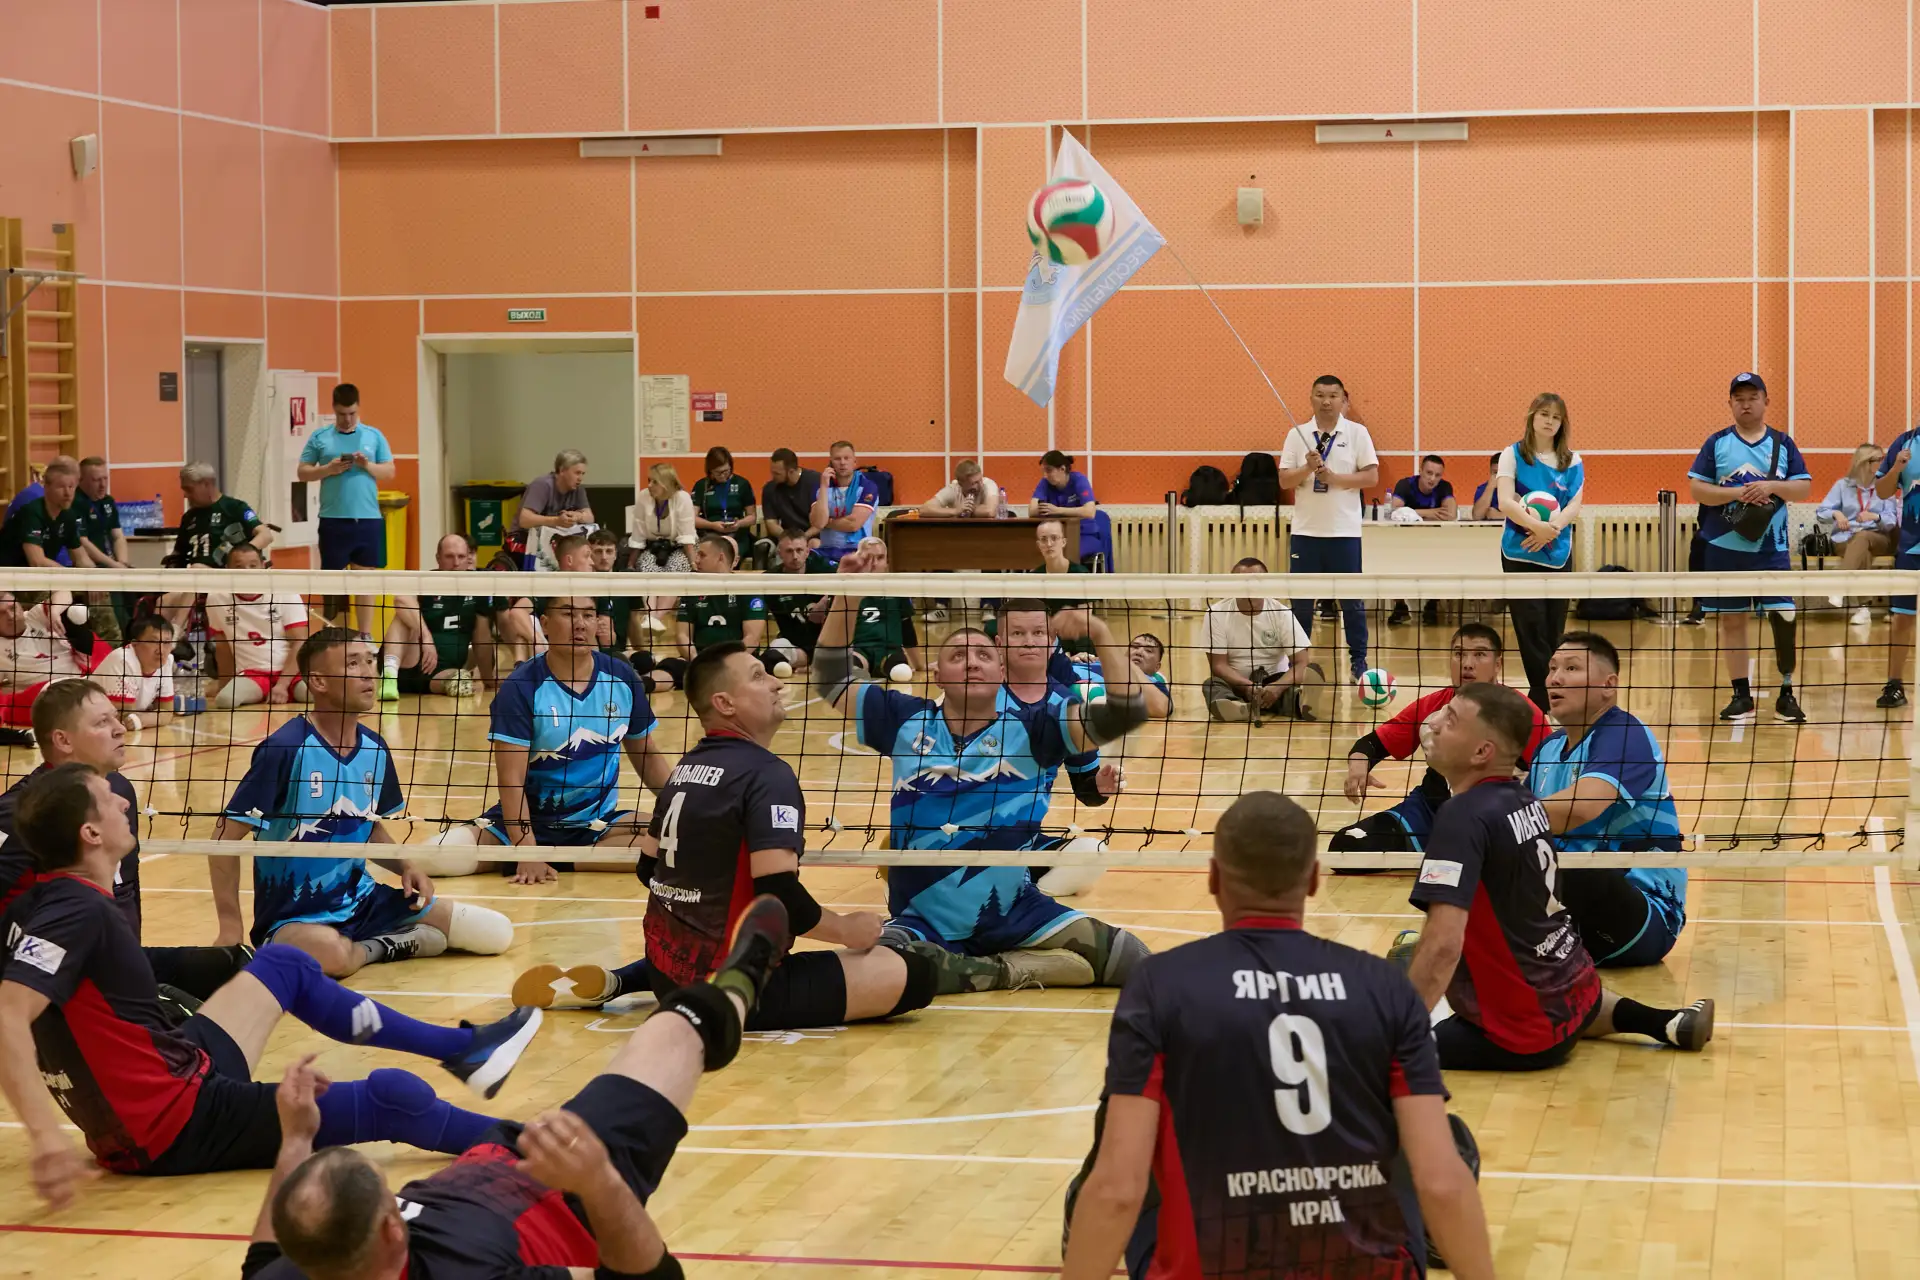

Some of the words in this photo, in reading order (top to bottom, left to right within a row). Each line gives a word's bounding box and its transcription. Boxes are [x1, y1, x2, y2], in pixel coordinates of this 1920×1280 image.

[510, 310, 542, 320] ВЫХОД
[862, 606, 881, 623] 2
[551, 705, 560, 727] 1
[310, 771, 324, 798] 9
[659, 791, 687, 868] 4
[1536, 838, 1565, 918] 2
[1232, 969, 1347, 1003] ЯРГИН
[1268, 1013, 1332, 1135] 9
[1226, 1160, 1387, 1197] КРАСНОЯРСКИЙ
